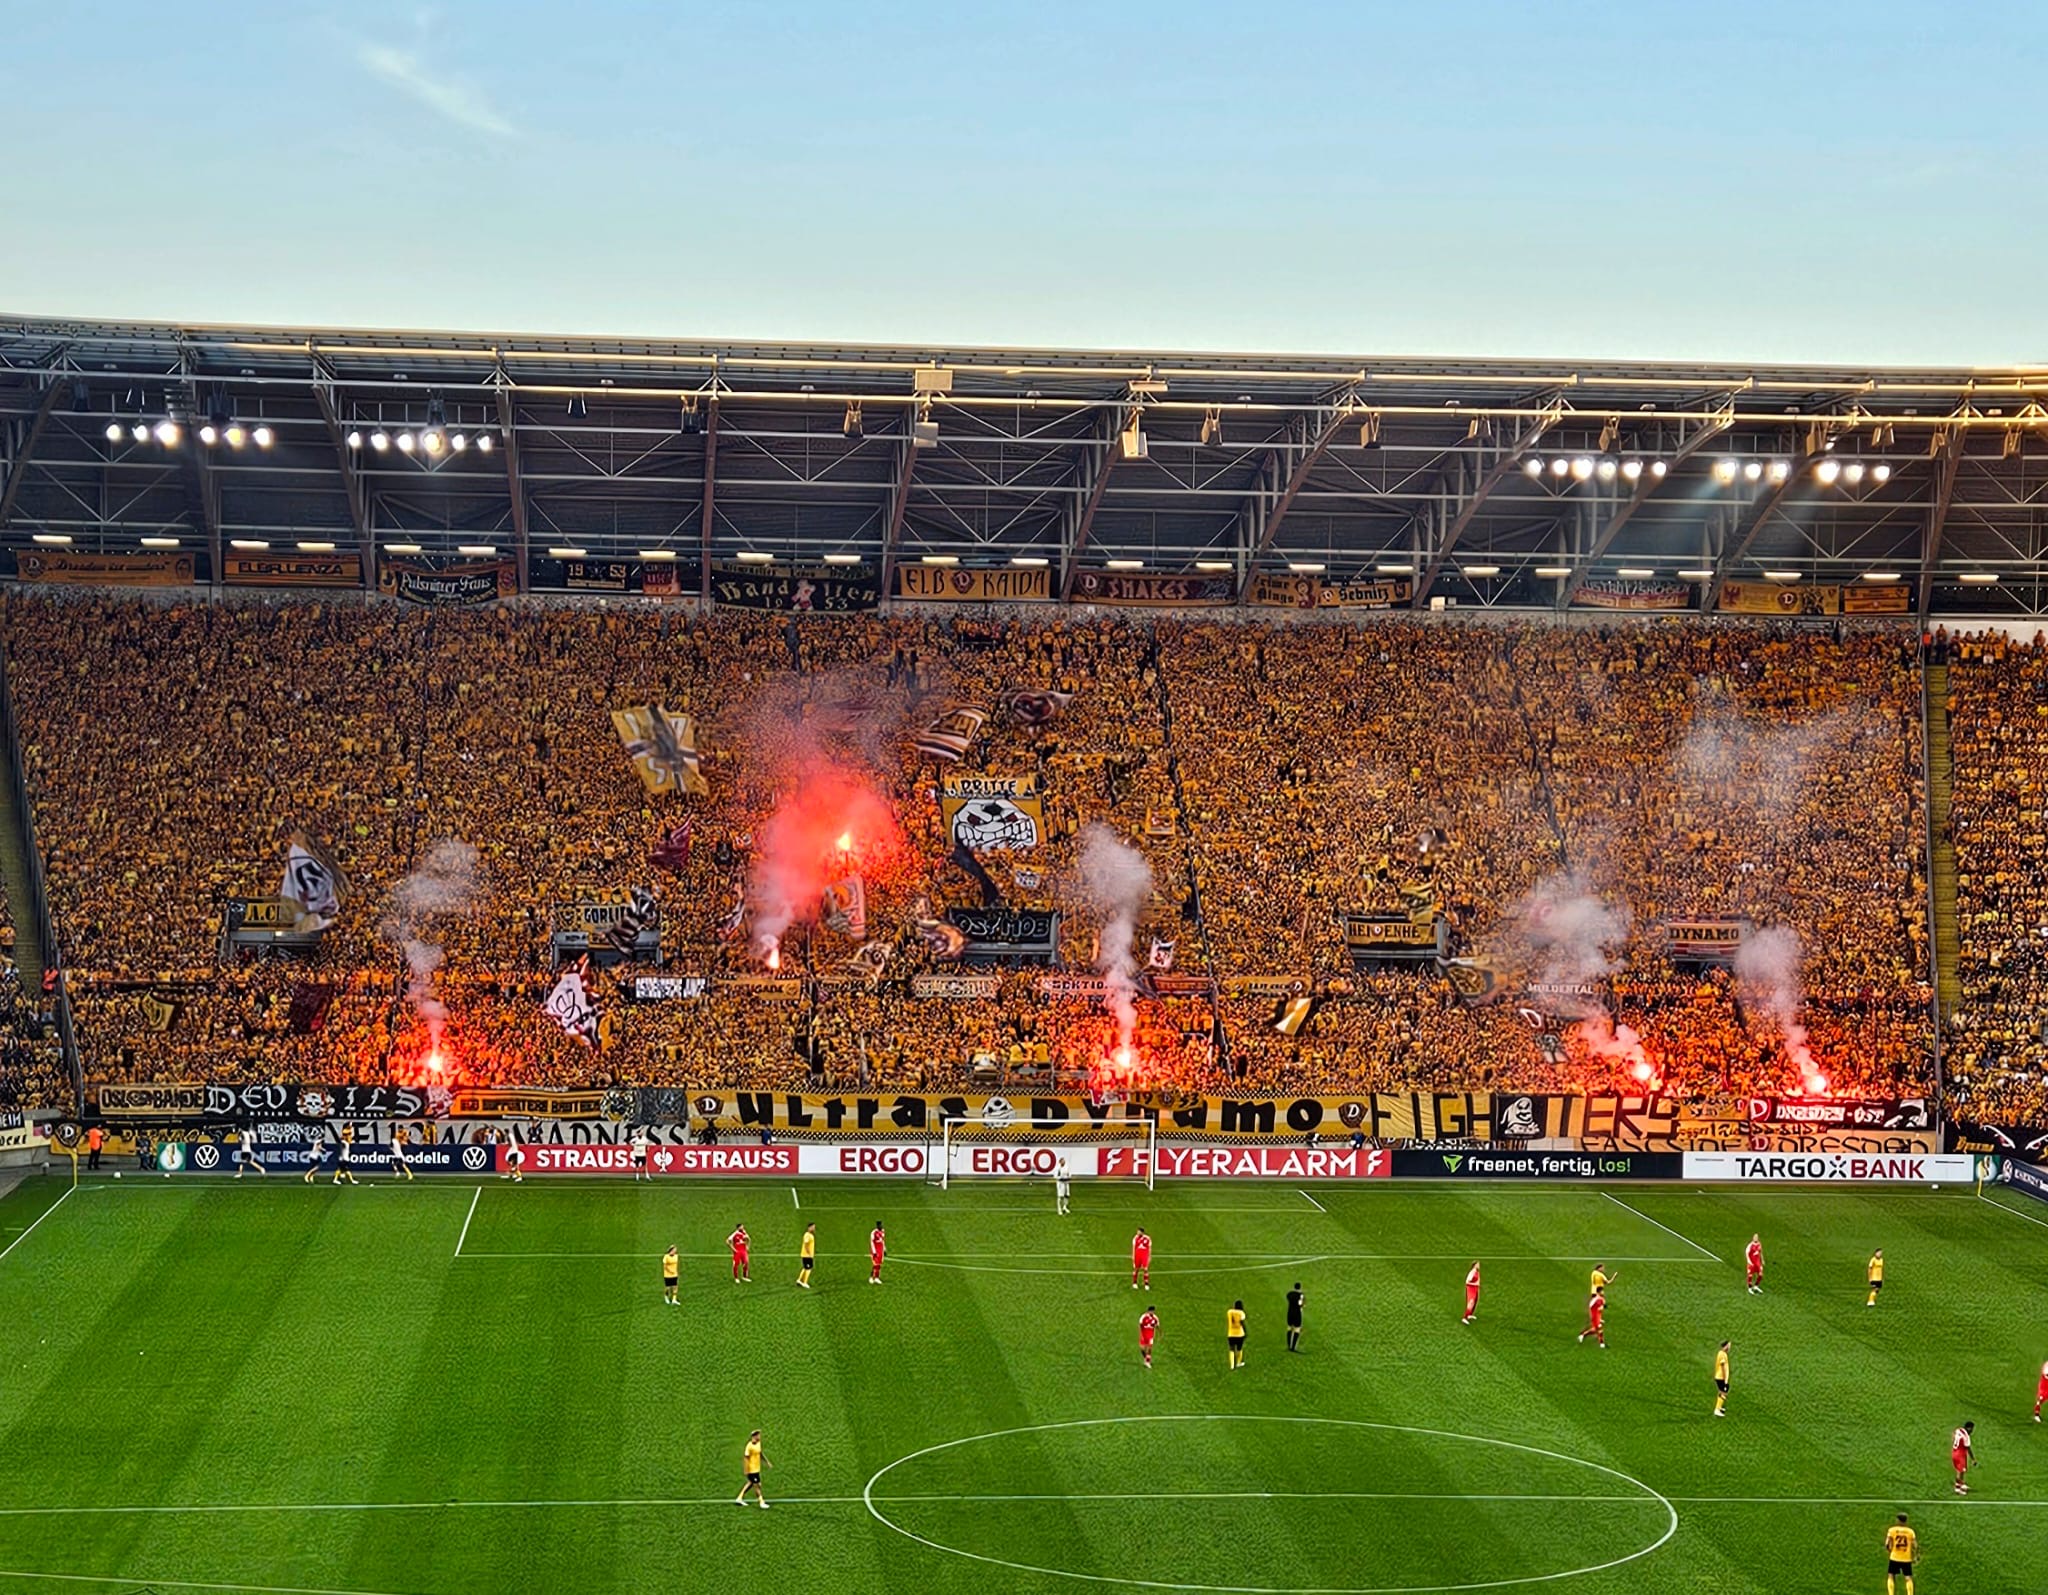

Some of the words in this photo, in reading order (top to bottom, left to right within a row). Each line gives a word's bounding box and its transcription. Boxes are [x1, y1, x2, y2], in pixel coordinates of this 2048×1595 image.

[568, 564, 584, 576] 19
[1670, 928, 1739, 940] DYNAMO
[684, 1151, 790, 1168] STRAUSS
[840, 1148, 924, 1172] ERGO
[972, 1149, 1057, 1173] ERGO
[1132, 1148, 1357, 1176] FLYERALARM
[1468, 1156, 1540, 1176] freenet,
[1541, 1156, 1596, 1176] fertig,
[1599, 1156, 1631, 1173] los!
